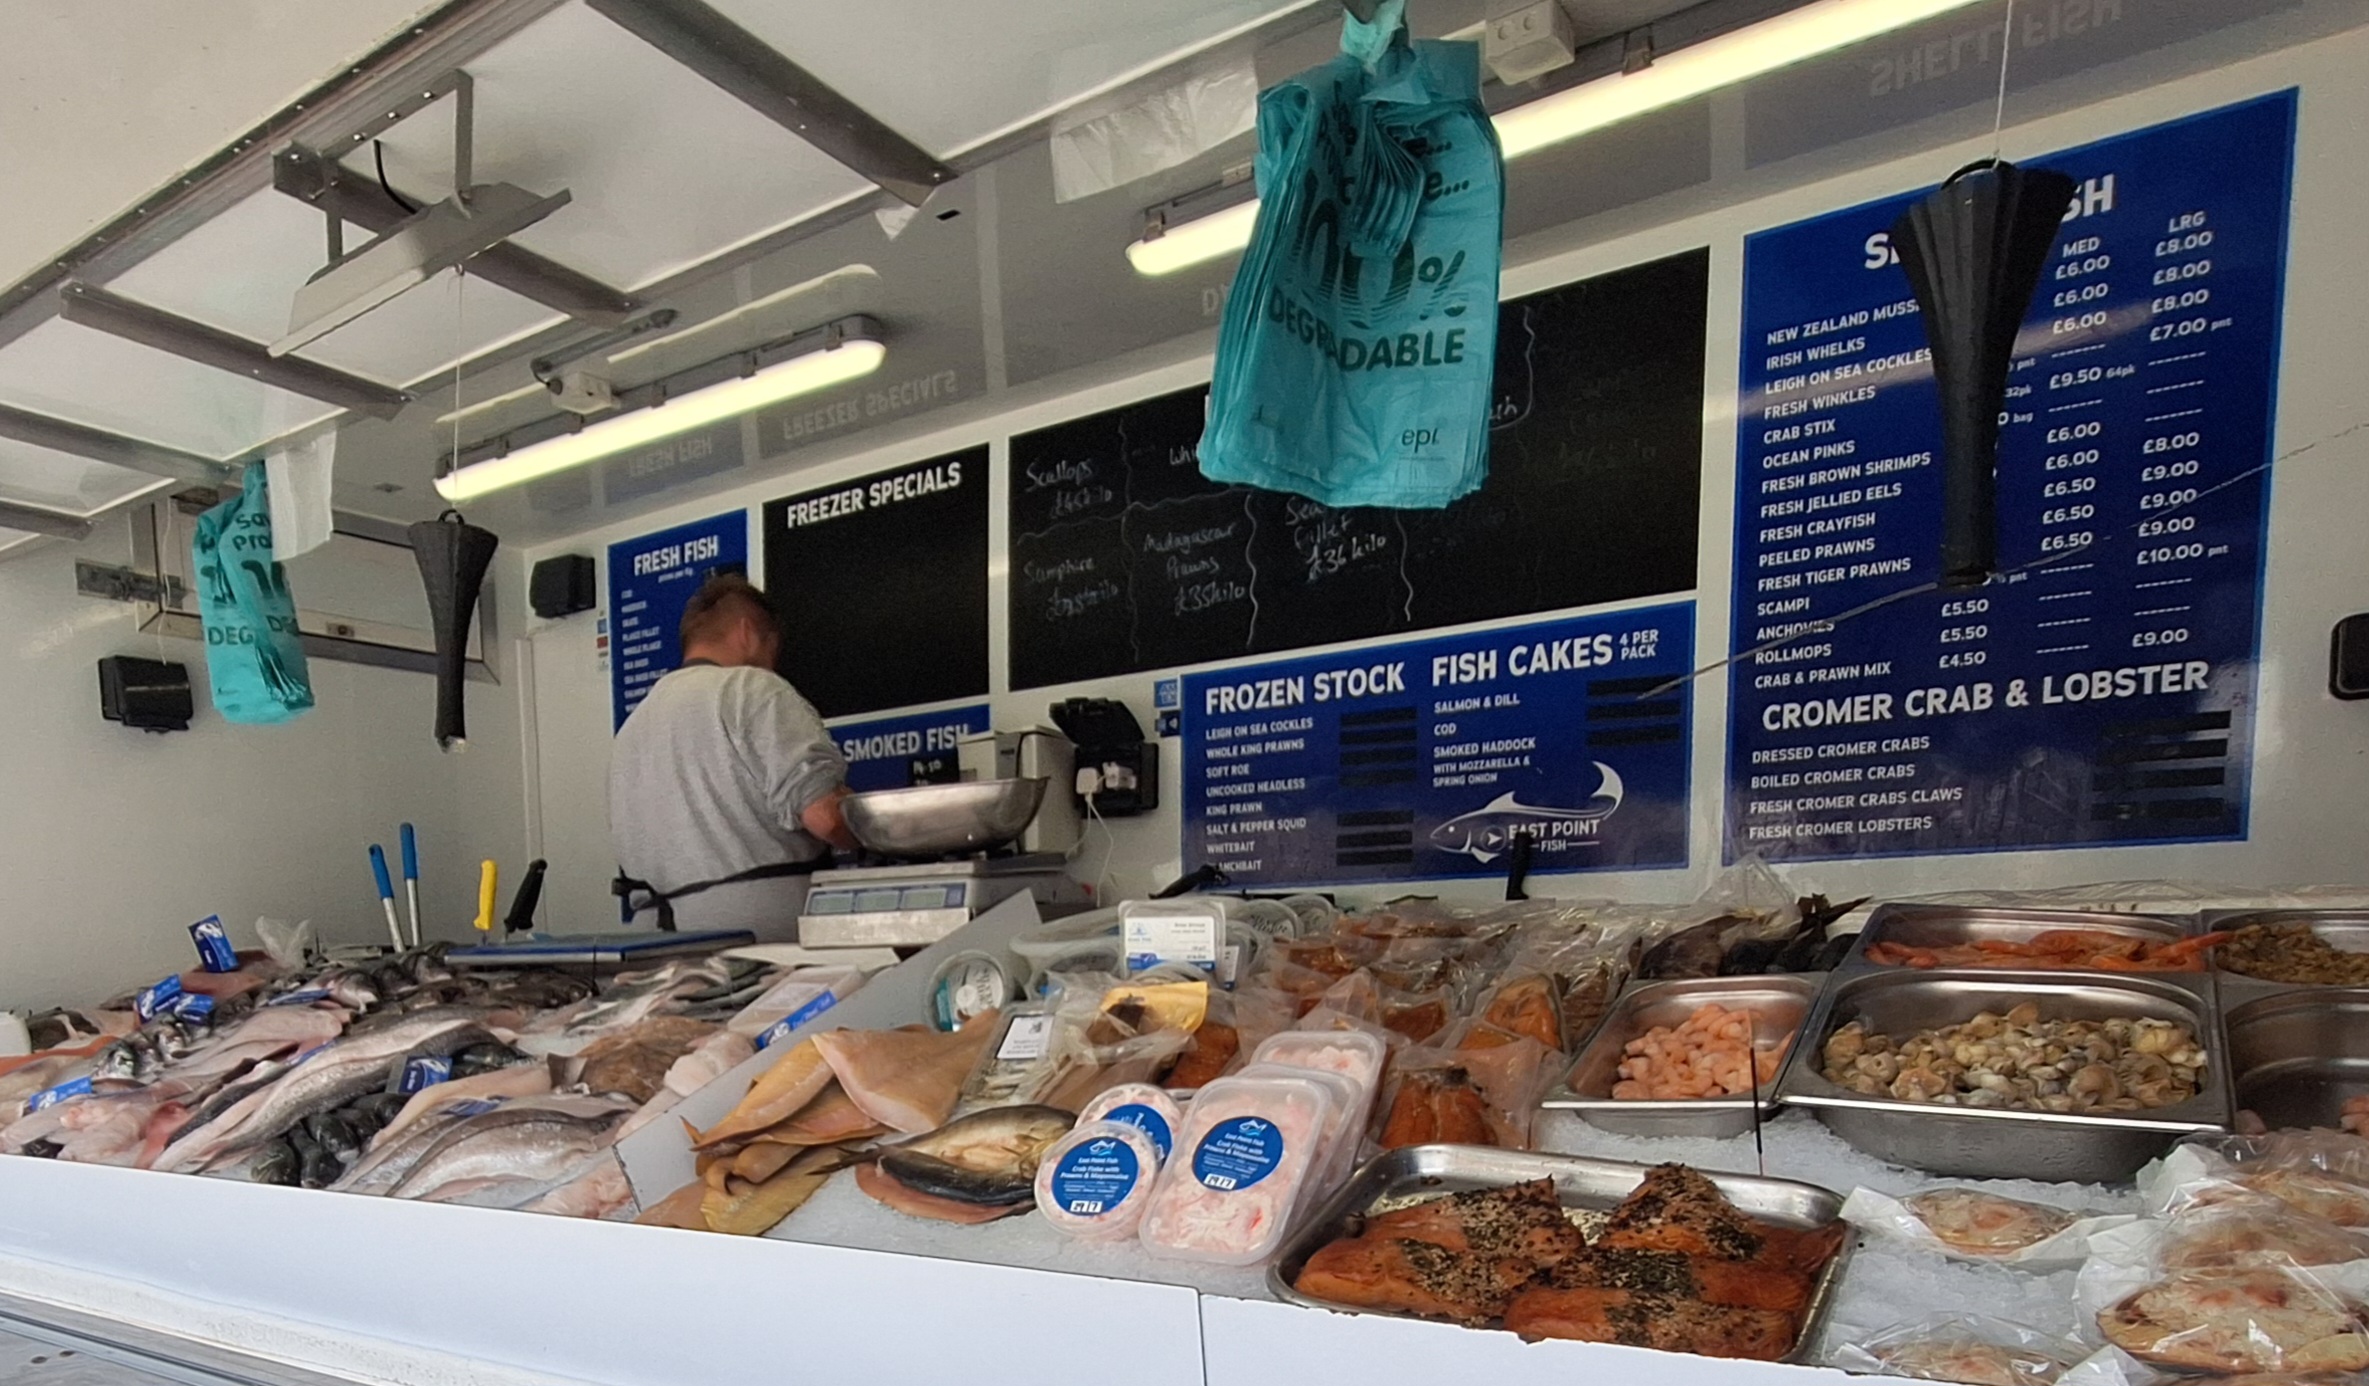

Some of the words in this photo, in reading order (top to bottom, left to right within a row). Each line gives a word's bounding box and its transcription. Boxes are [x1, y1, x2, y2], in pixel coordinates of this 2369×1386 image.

[2169, 211, 2205, 233] LRG
[2063, 237, 2100, 257] MED
[2156, 231, 2213, 256] £8.00
[2055, 255, 2111, 280] £6.00
[2153, 260, 2211, 285] £8.00
[2054, 283, 2109, 307] £6.00
[2151, 288, 2209, 314] £8.00
[1267, 284, 1466, 372] DEGRADABLE
[1767, 327, 1799, 345] NEW
[1802, 311, 1869, 337] ZEALAND
[1873, 299, 1920, 321] MUSS
[2053, 311, 2107, 335] £6.00
[2150, 318, 2206, 342] £7.00
[2211, 317, 2233, 331] pnt
[1767, 351, 1802, 371] IRISH
[1807, 337, 1866, 361] WHELKS
[1765, 376, 1805, 395] LEIGH
[1809, 370, 1830, 387] ON
[1834, 363, 1862, 382] SEA
[1866, 348, 1932, 373] COCKLES
[2050, 366, 2101, 389] £9.50
[2106, 364, 2135, 379] 64pk
[1764, 399, 1807, 420] FRESH
[1812, 385, 1876, 410] WINKLES
[2012, 412, 2034, 424] bag
[1764, 424, 1800, 444] CRAB
[1804, 418, 1836, 437] STIX
[2047, 421, 2101, 444] £6.00
[1763, 449, 1809, 469] OCEAN
[1813, 440, 1856, 460] PINKS
[2143, 432, 2200, 455] £8.00
[2045, 449, 2099, 471] £6.00
[2142, 460, 2199, 482] £9.00
[1025, 458, 1093, 492] Scallops
[1762, 475, 1805, 494] FRESH
[1809, 464, 1861, 486] BROWN
[1865, 452, 1931, 475] SHRIMPS
[787, 487, 865, 529] FREEZER
[869, 462, 962, 508] SPECIALS
[2044, 476, 2096, 498] £6.50
[1761, 499, 1804, 519] FRESH
[1807, 490, 1862, 513] JELLIED
[1866, 482, 1902, 501] EELS
[2140, 488, 2197, 510] £9.00
[2042, 504, 2095, 525] £6.50
[1760, 524, 1803, 544] FRESH
[1807, 512, 1876, 535] CRAYFISH
[2138, 516, 2195, 538] £9.00
[1759, 548, 1810, 567] PEELED
[1815, 537, 1876, 559] PRAWNS
[2041, 531, 2093, 551] £6.50
[633, 545, 681, 576] FRESH
[684, 535, 719, 563] FISH
[2137, 543, 2203, 565] £10.00
[2208, 545, 2229, 557] pnt
[1758, 573, 1801, 592] FRESH
[1806, 566, 1845, 586] TIGER
[1850, 557, 1911, 579] PRAWNS
[1757, 597, 1810, 617] SCAMPI
[1941, 599, 1989, 617] £5.50
[1619, 632, 1630, 646] 4
[1632, 629, 1659, 644] PER
[1940, 625, 1988, 643] £5.50
[2132, 628, 2189, 648] £9.00
[1432, 649, 1497, 687] FISH
[1508, 633, 1612, 677] CAKES
[1621, 644, 1656, 661] PACK
[1755, 643, 1832, 665] ROLLMOPS
[1939, 651, 1987, 669] £4.50
[1755, 672, 1791, 689] CRAB
[1795, 671, 1805, 684] &
[1809, 665, 1860, 683] PRAWN
[1864, 661, 1892, 677] MIX
[1206, 676, 1304, 715] FROZEN
[1313, 662, 1405, 702] STOCK
[1762, 693, 1893, 731] CROMER
[1904, 682, 1994, 717] CRAB
[2005, 678, 2029, 708] &
[2042, 660, 2209, 705] LOBSTER
[1434, 696, 1481, 714] SALMON
[1483, 695, 1491, 708] &
[1494, 693, 1520, 707] DILL
[1206, 726, 1232, 740] LEIGH
[1234, 723, 1248, 737] ON
[1250, 721, 1268, 735] SEA
[1270, 716, 1313, 733] COCKLES
[1434, 723, 1457, 736] COD
[844, 731, 921, 762] SMOKED
[1206, 745, 1238, 760] WHOLE
[1240, 742, 1262, 756] KING
[1264, 738, 1305, 753] PRAWNS
[1433, 742, 1479, 759] SMOKED
[1481, 737, 1536, 754] HADDOCK
[1752, 746, 1814, 764] DRESSED
[1817, 740, 1876, 758] CROMER
[1881, 736, 1930, 752] CRABS
[1206, 766, 1229, 779] SOFT
[1231, 764, 1250, 776] ROE
[1433, 762, 1457, 774] WITH
[1458, 758, 1521, 772] MOZZARELLA
[1523, 755, 1531, 767] &
[1751, 773, 1800, 789] BOILED
[1803, 768, 1863, 785] CROMER
[1867, 763, 1916, 779] CRABS
[1206, 781, 1255, 798] UNCOOKED
[1257, 778, 1306, 793] HEADLESS
[1433, 775, 1465, 788] SPRING
[1468, 772, 1498, 785] ONION
[1206, 804, 1228, 817] KING
[1229, 802, 1263, 814] PRAWN
[1750, 801, 1792, 815] FRESH
[1796, 795, 1855, 811] CROMER
[1859, 790, 1907, 807] CRABS
[1911, 787, 1963, 802] CLAWS
[1206, 823, 1229, 835] SALT
[1230, 821, 1238, 833] &
[1240, 819, 1275, 833] PEPPER
[1277, 818, 1307, 832] SQUID
[1551, 819, 1599, 836] POINT
[1749, 825, 1792, 840] FRESH
[1796, 821, 1853, 836] CROMER
[1858, 816, 1933, 833] LOBSTERS
[1206, 841, 1255, 855] WHITEBAIT
[1540, 840, 1567, 852] FISH
[1217, 860, 1262, 873] ANCHBAIT
